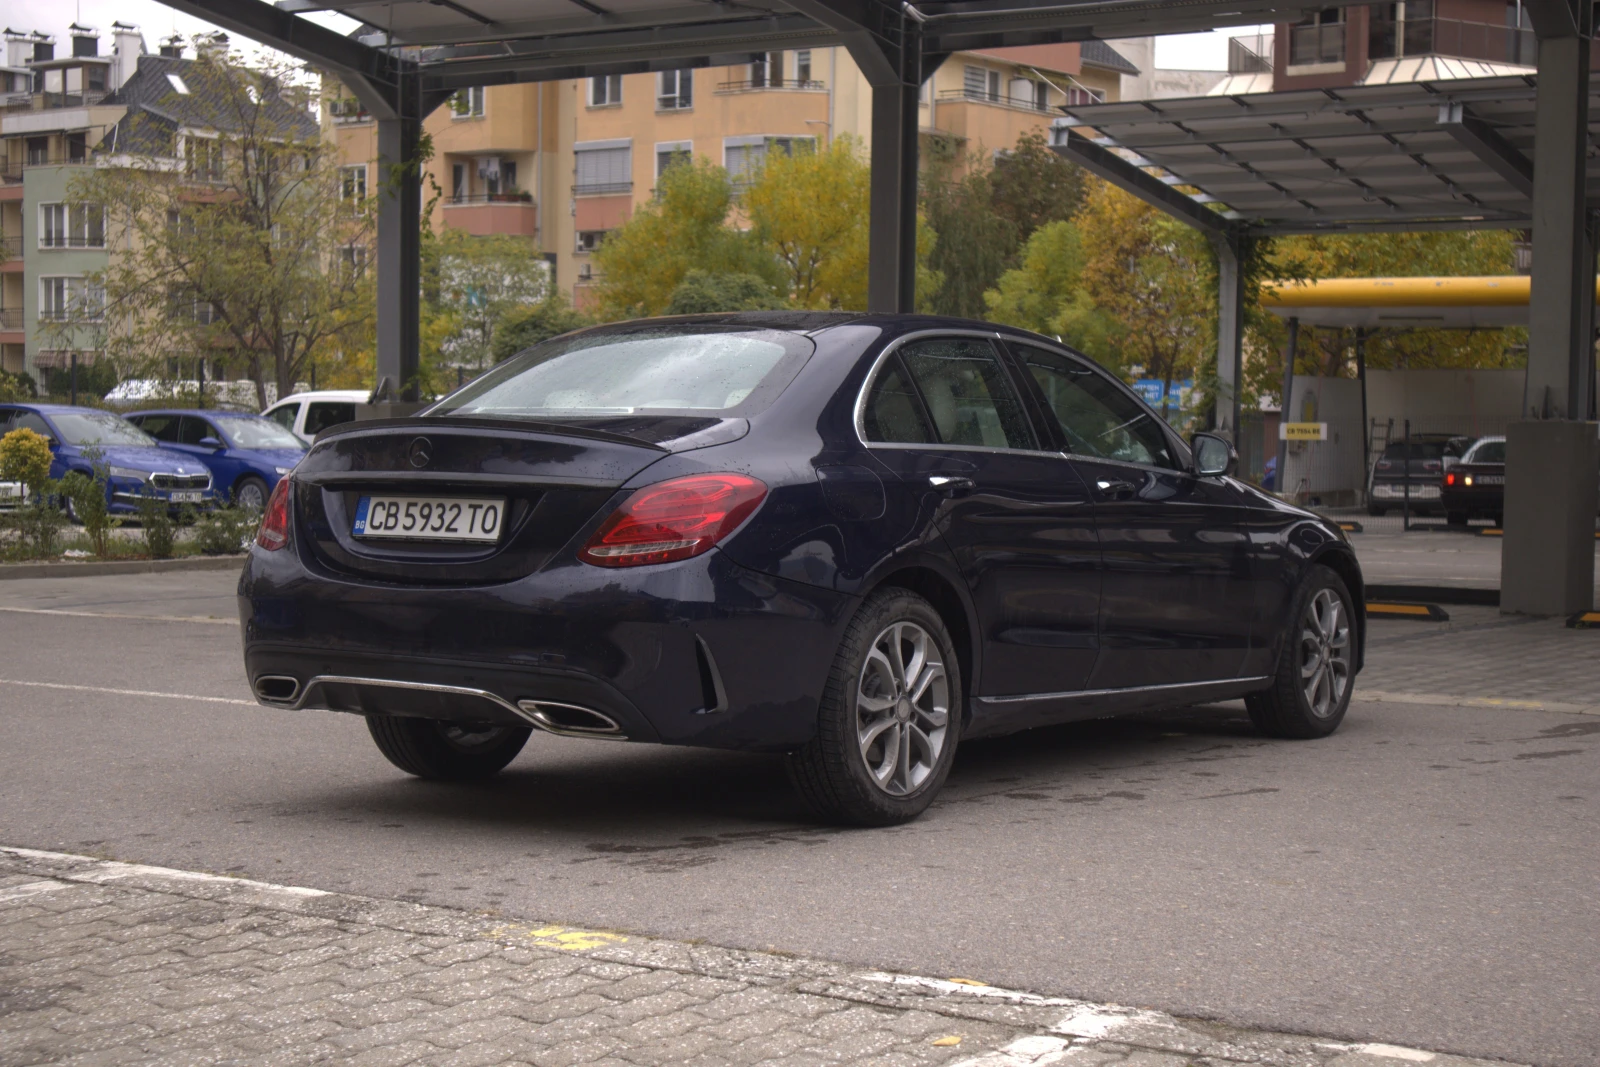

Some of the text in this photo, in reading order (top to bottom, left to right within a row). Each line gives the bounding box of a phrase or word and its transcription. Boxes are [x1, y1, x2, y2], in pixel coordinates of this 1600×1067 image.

[355, 520, 365, 529] BG
[370, 502, 498, 534] CB 5932 TO
